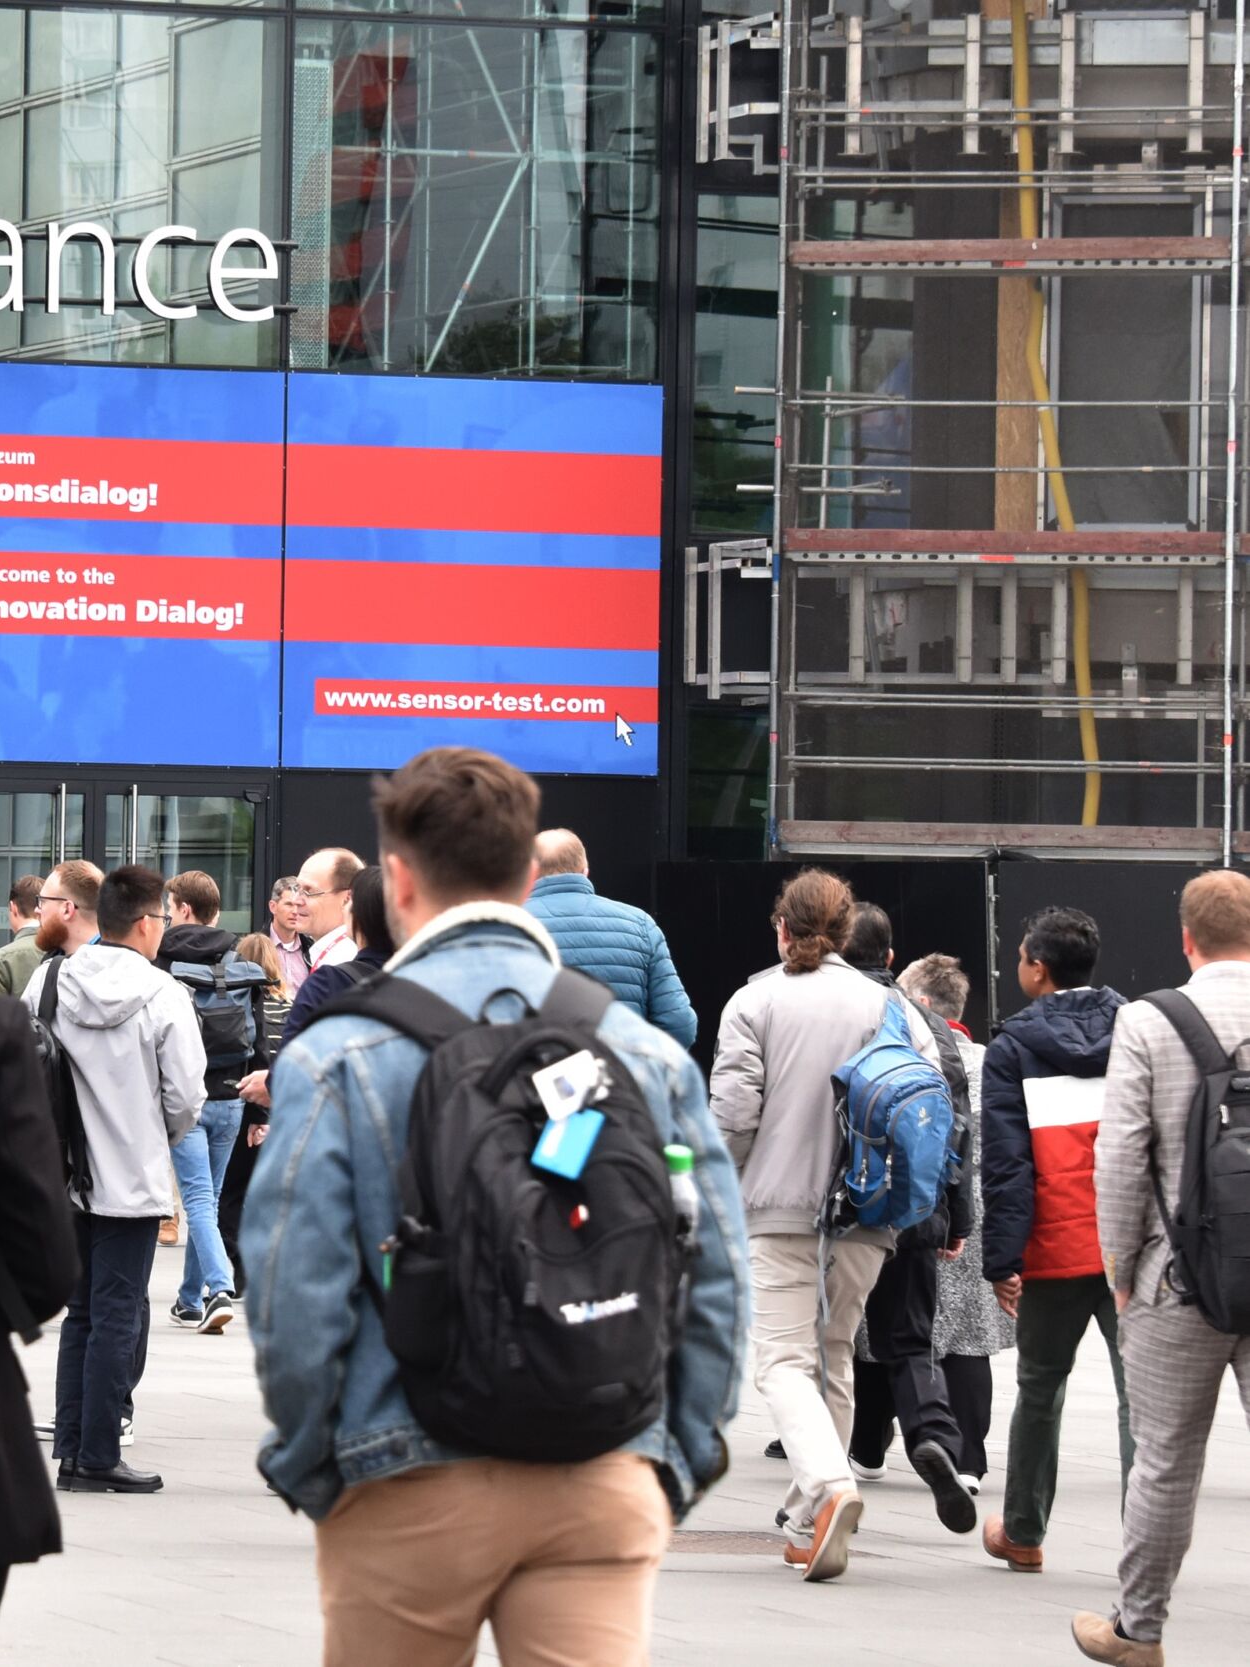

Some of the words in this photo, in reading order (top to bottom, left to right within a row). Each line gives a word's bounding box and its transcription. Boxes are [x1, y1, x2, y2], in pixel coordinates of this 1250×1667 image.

[56, 567, 77, 584] to
[83, 567, 116, 585] the
[136, 600, 244, 631] Dialog!
[324, 691, 606, 714] www.sensor-test.com
